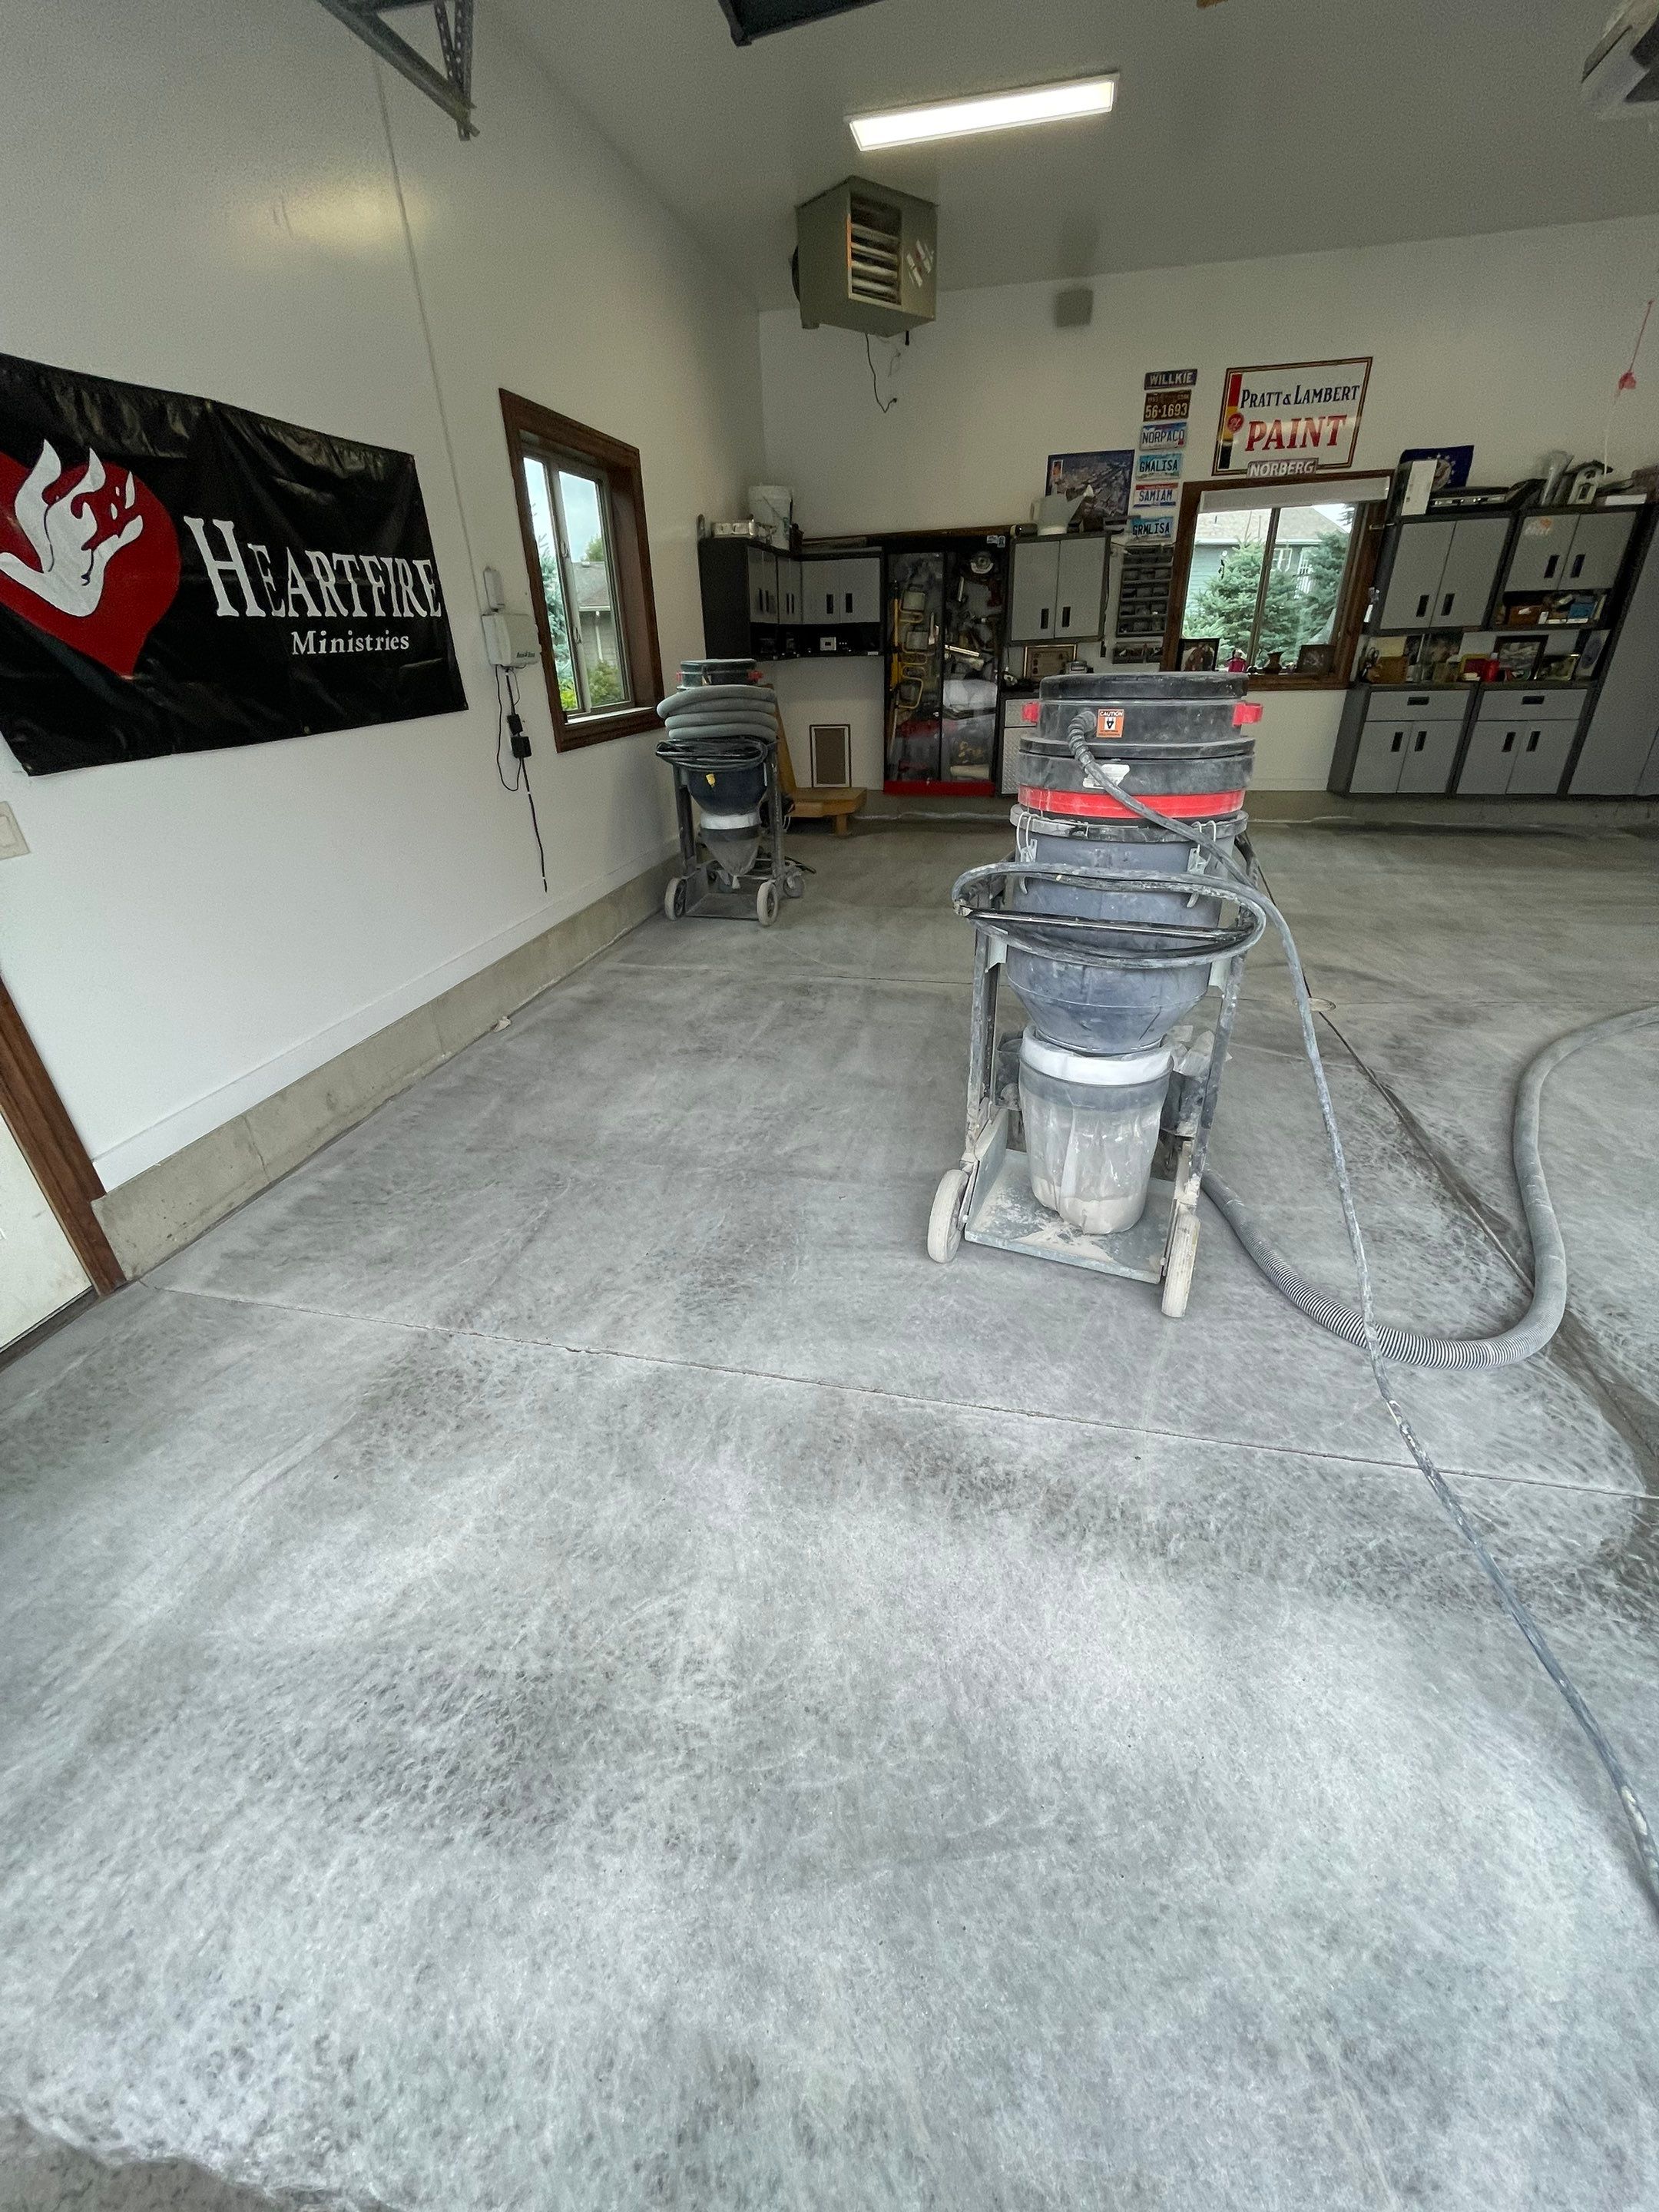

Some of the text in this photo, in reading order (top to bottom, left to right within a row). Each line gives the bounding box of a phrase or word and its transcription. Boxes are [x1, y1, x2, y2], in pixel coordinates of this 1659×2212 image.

[1150, 372, 1194, 386] WILLKIE
[1240, 389, 1283, 409] PRATT
[1293, 384, 1360, 405] LAMBERT
[1244, 414, 1348, 452] PAINT
[1139, 459, 1177, 472] GMALISA
[1250, 460, 1314, 478] NORBERG
[1132, 522, 1170, 535] GRMLISA
[183, 515, 442, 618] HEARTFIRE
[290, 630, 409, 656] Ministries
